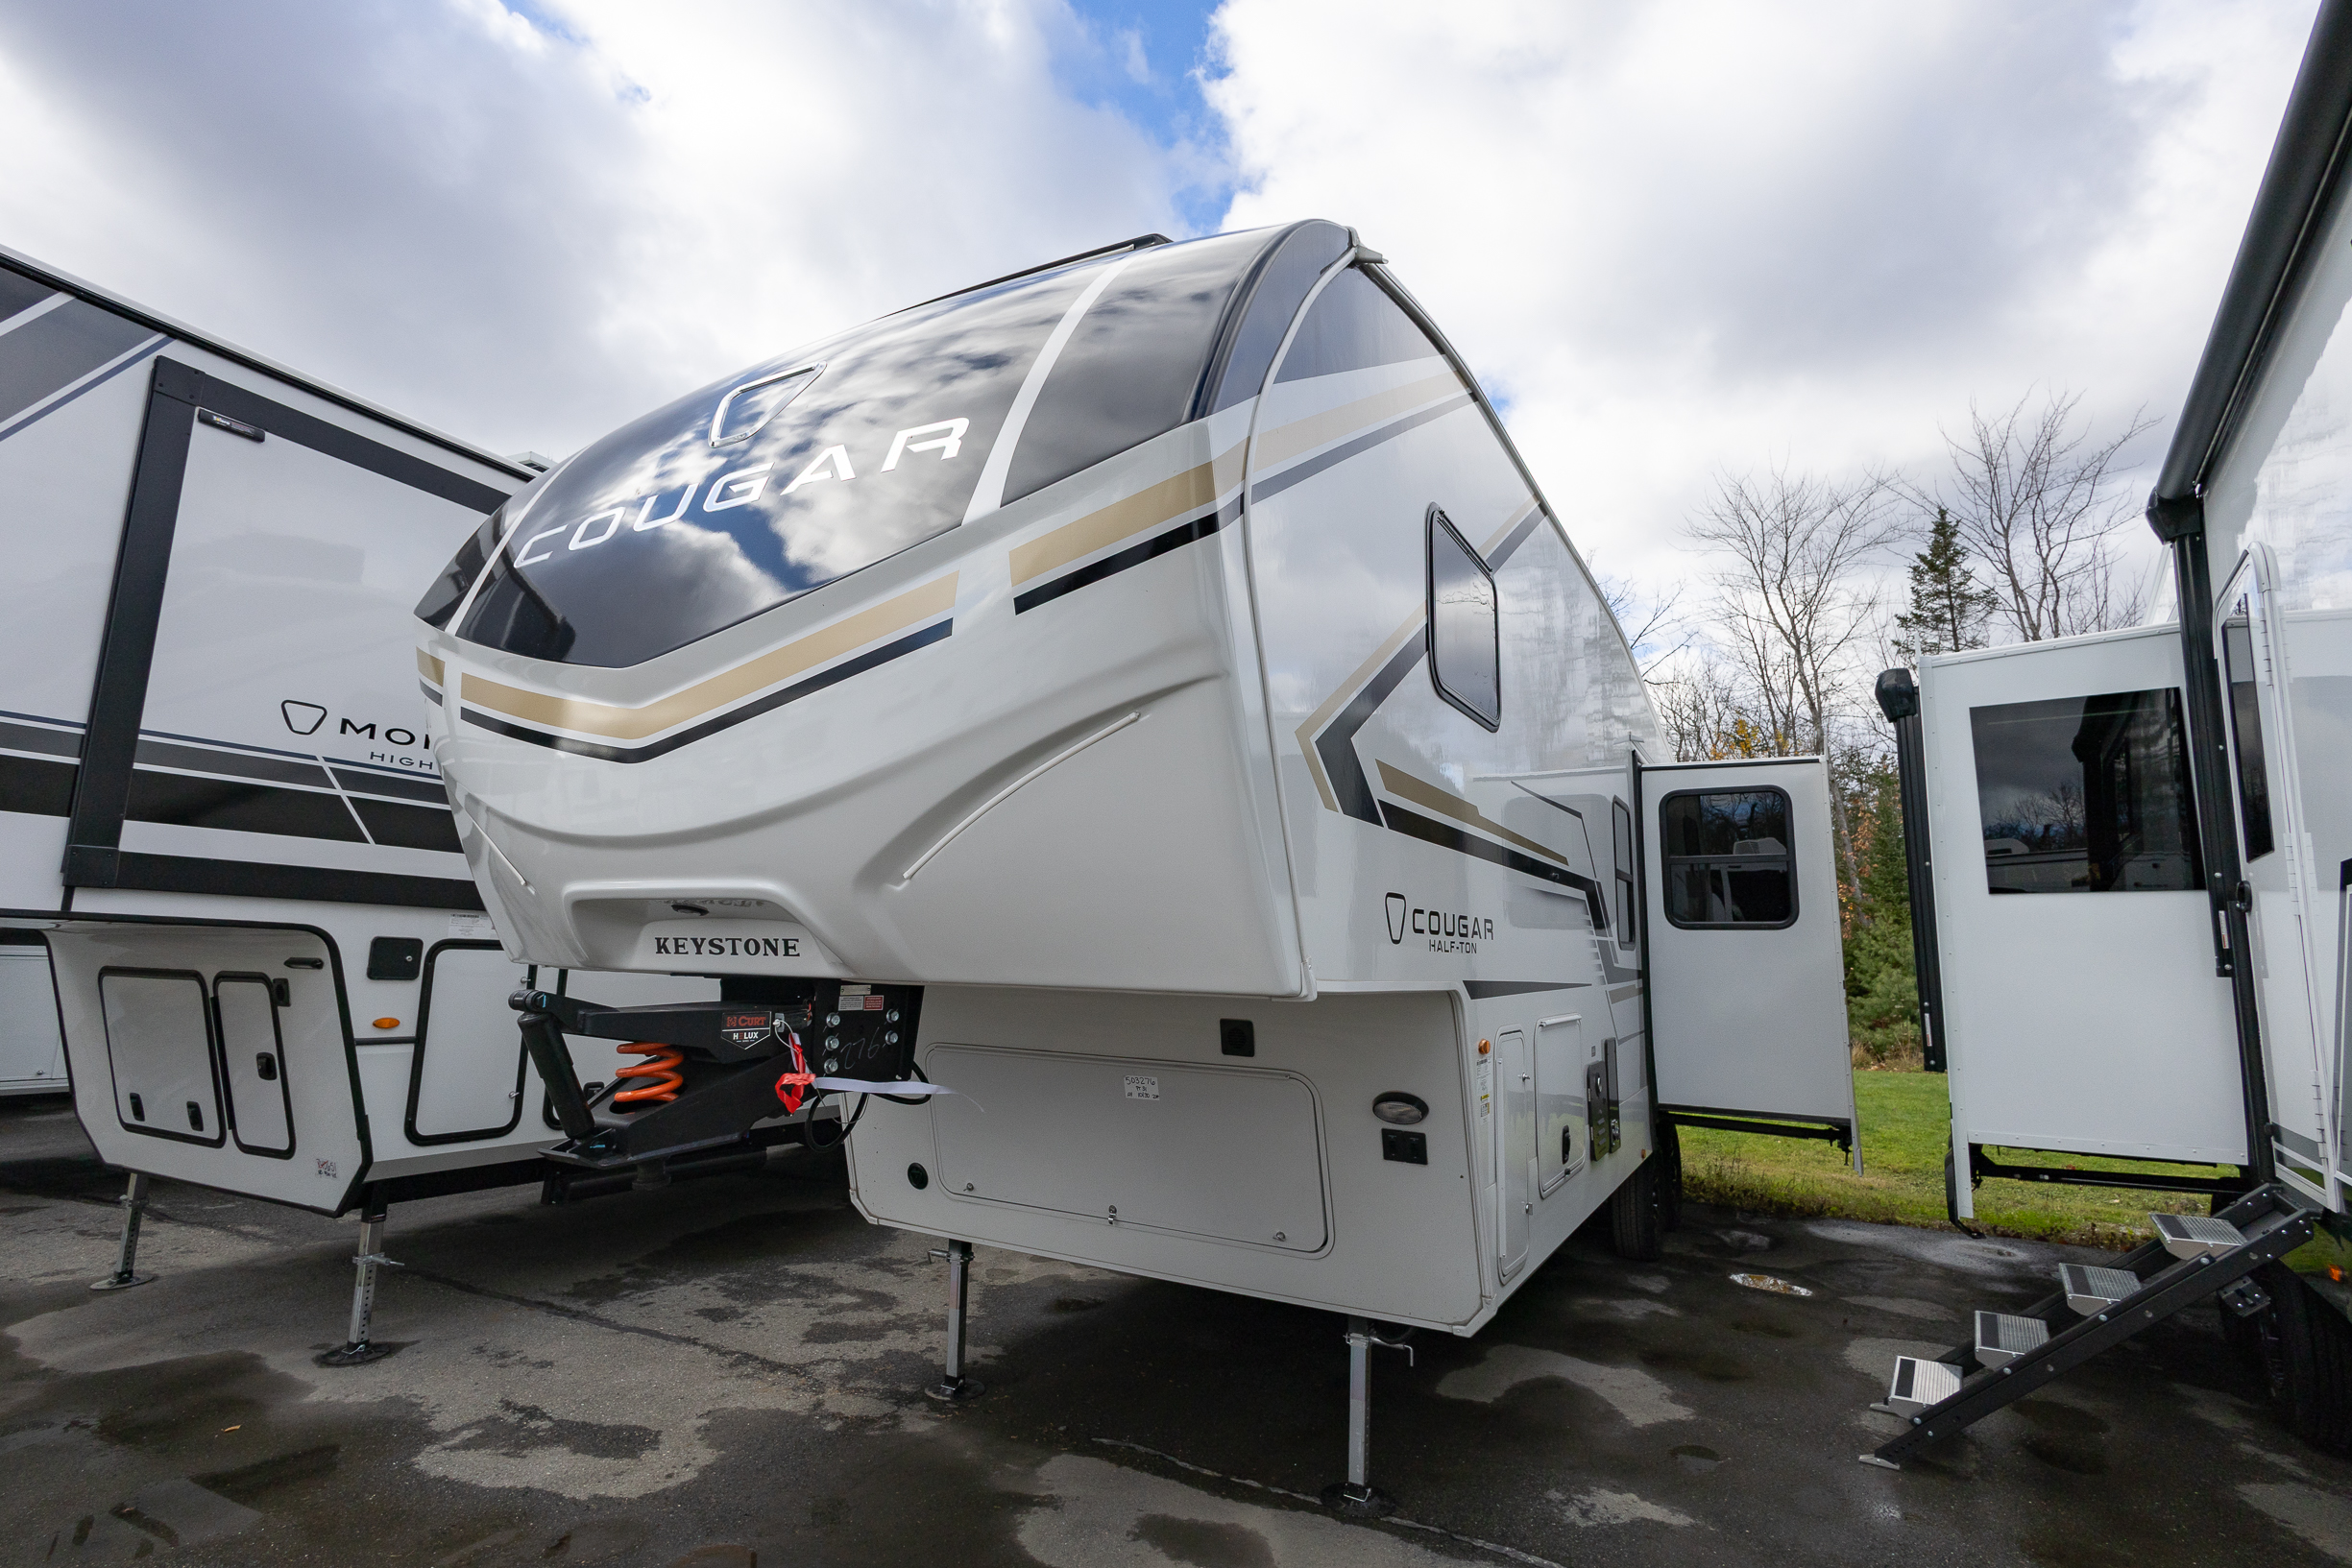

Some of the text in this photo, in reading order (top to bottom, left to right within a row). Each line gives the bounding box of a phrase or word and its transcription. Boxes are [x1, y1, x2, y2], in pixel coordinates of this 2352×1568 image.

[514, 417, 971, 568] COUGAR
[370, 751, 433, 770] HIGH
[1412, 908, 1493, 940] COUGAR
[654, 936, 801, 957] KEYSTONE
[1428, 939, 1477, 953] HALF-TON
[733, 1031, 759, 1040] HELUX
